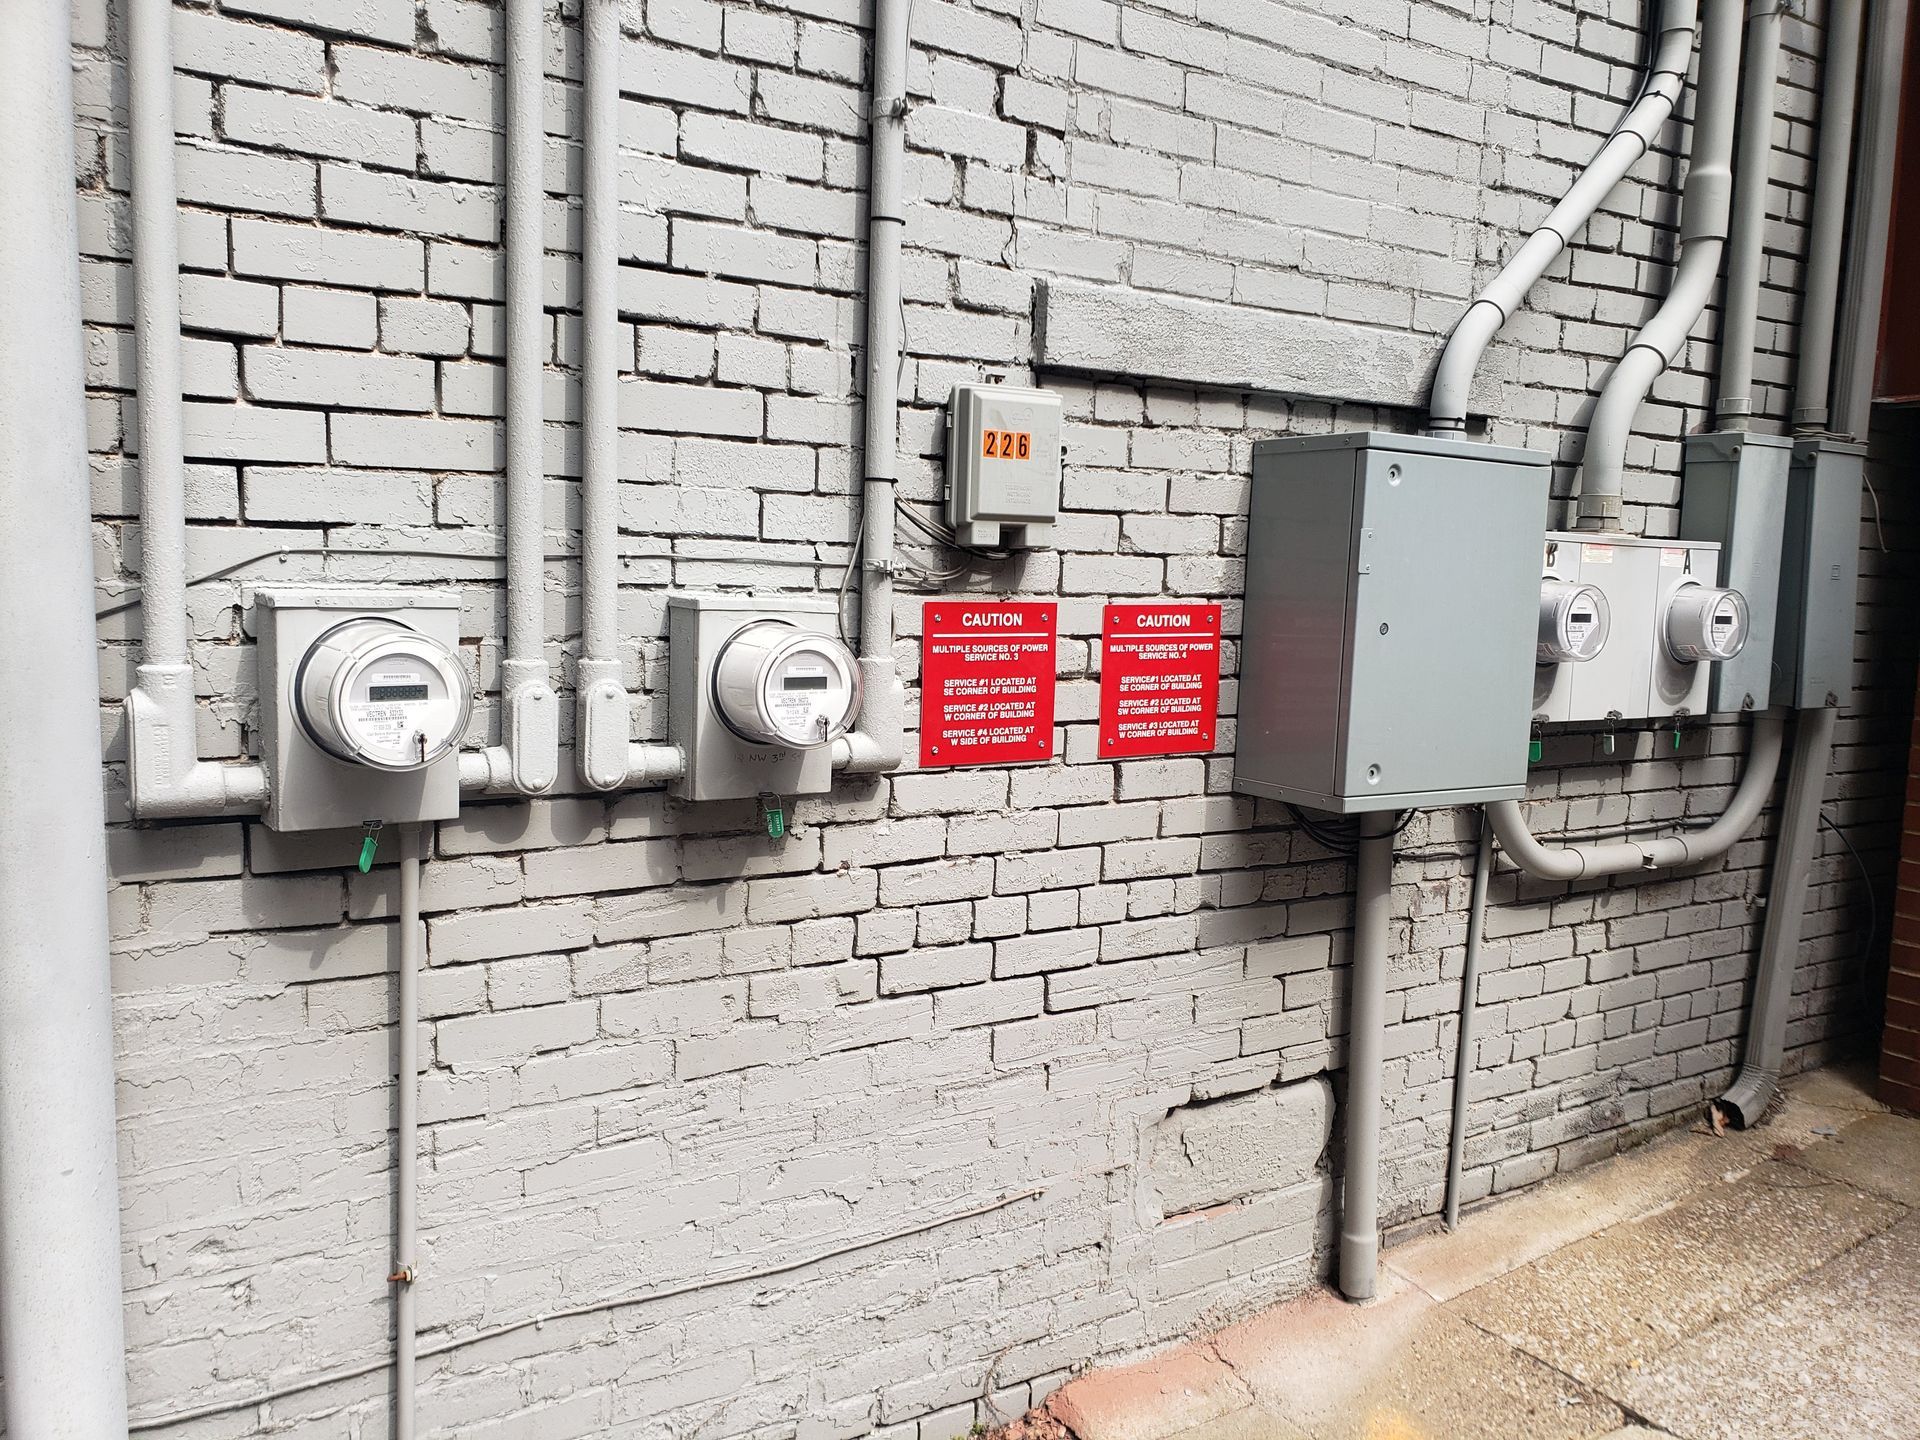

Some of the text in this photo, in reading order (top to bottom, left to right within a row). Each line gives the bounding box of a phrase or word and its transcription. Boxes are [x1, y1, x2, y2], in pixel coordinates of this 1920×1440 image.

[986, 432, 1027, 457] 226
[1683, 549, 1692, 574] A
[962, 613, 1022, 626] CAUTION
[1137, 615, 1190, 627] CAUTION
[932, 645, 970, 653] MULTIPLE
[1002, 686, 1036, 694] BUILDING
[1171, 705, 1202, 713] BUILDING
[1000, 711, 1034, 719] BUILDING
[1168, 728, 1198, 736] BUILDING
[992, 735, 1026, 743] BUILDING
[749, 754, 767, 762] NW
